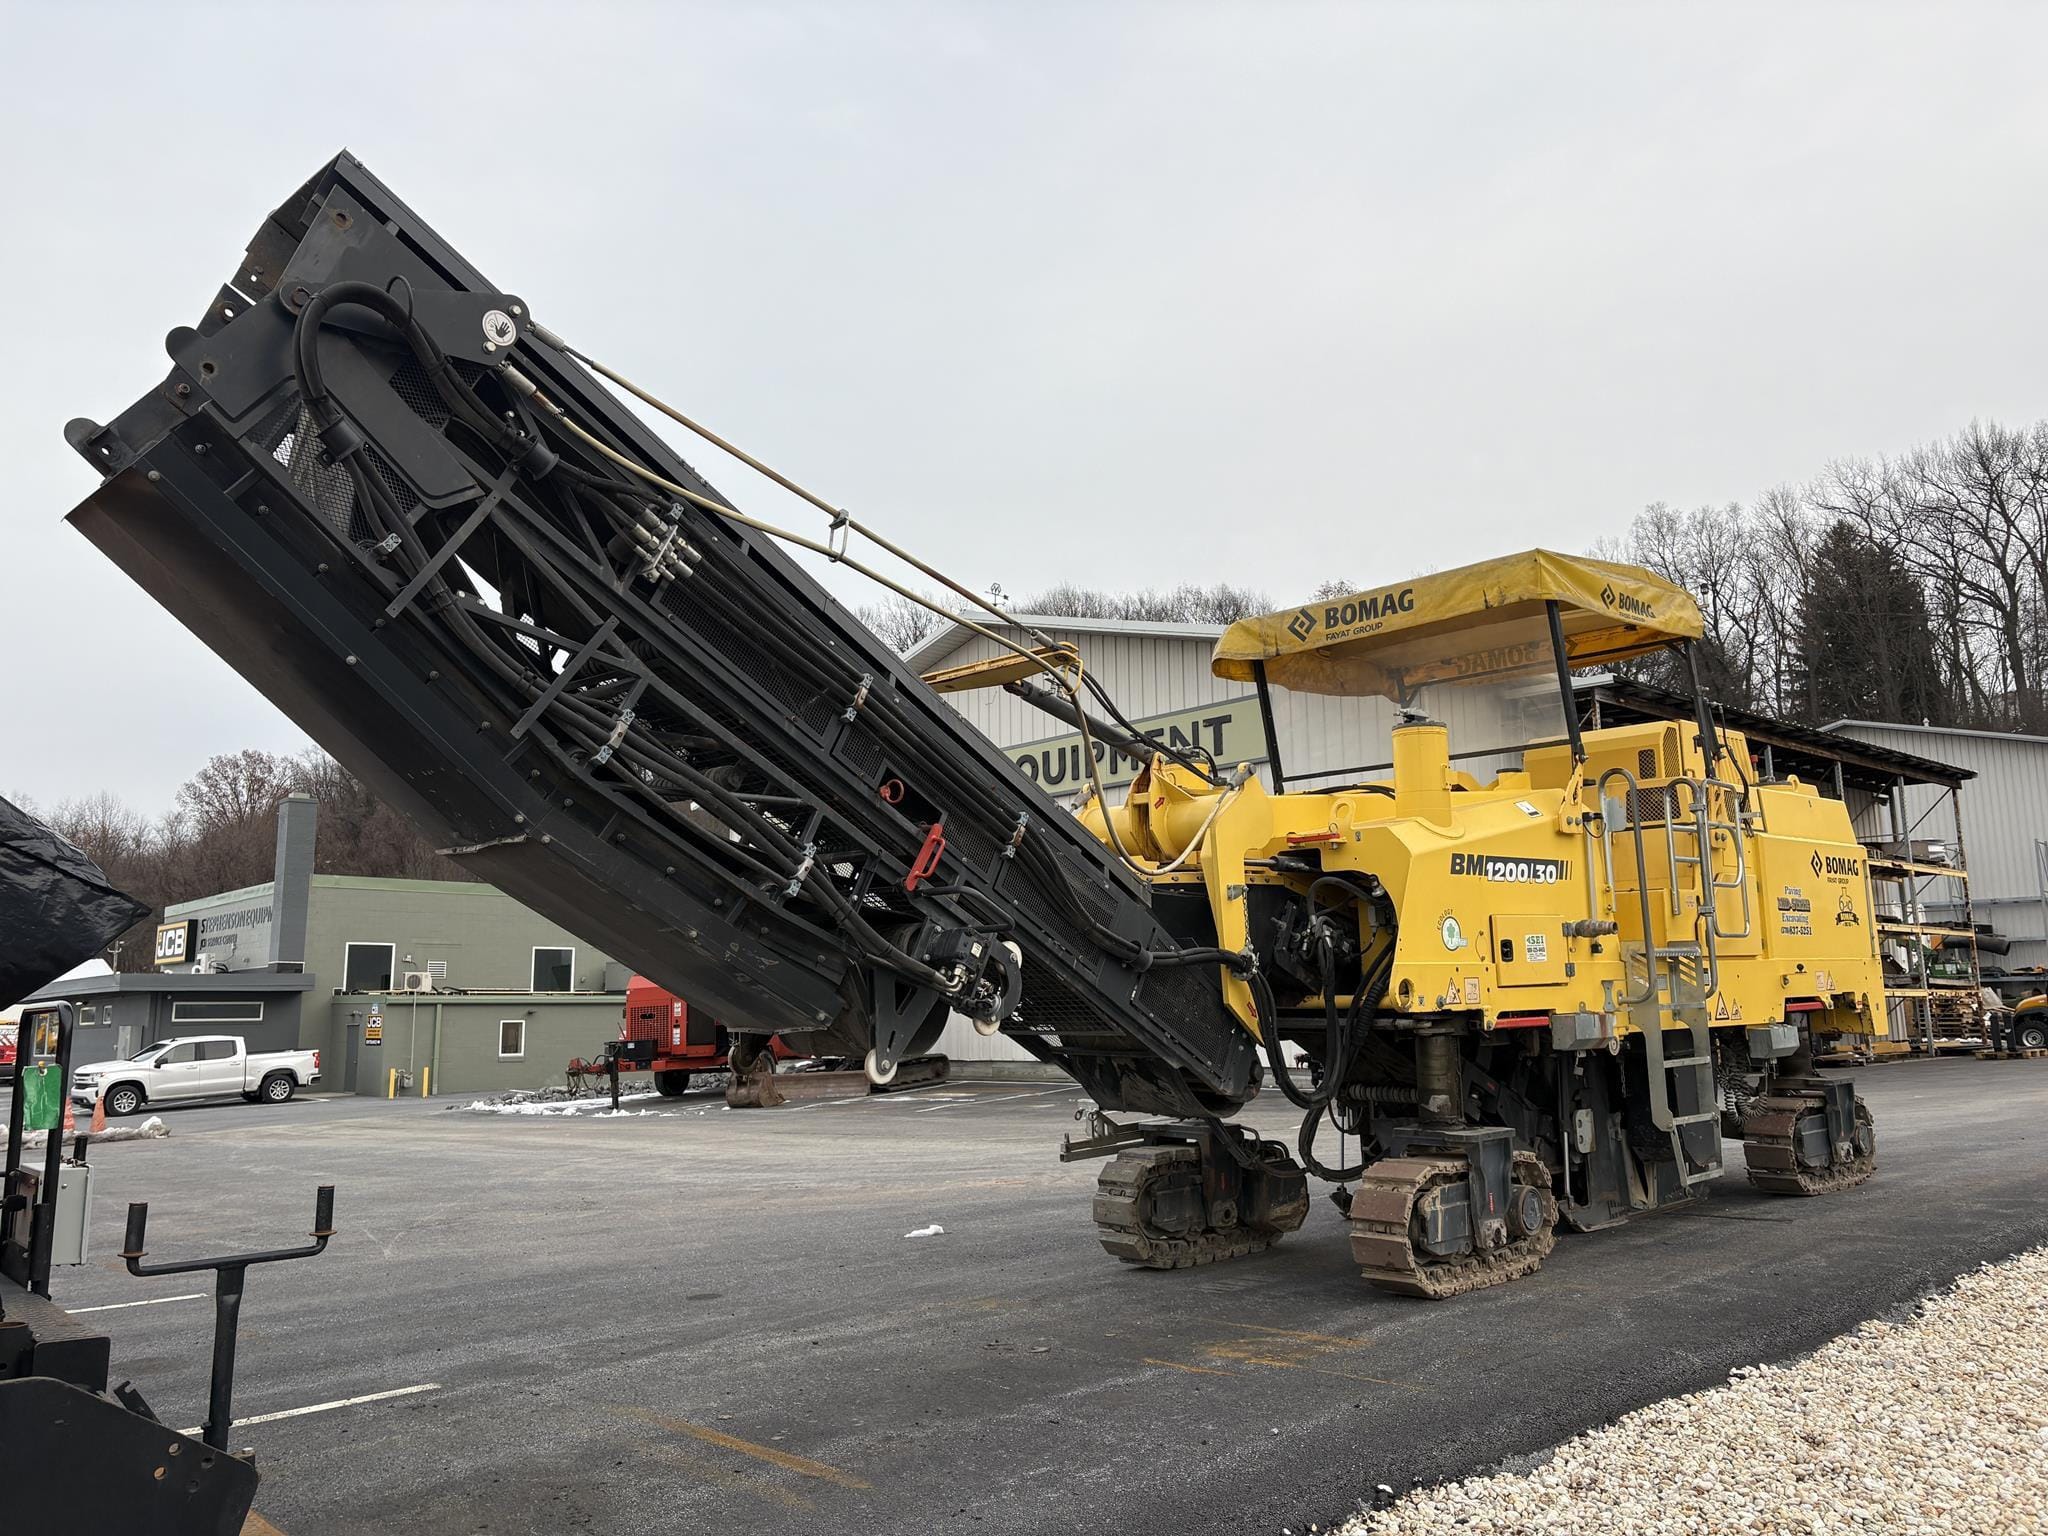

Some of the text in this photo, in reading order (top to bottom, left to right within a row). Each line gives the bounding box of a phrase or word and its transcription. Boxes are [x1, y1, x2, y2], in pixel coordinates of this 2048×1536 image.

[1325, 588, 1414, 629] BOMAG
[1618, 592, 1656, 618] BOMAG
[1325, 621, 1383, 641] FAYAT GROUP
[1825, 856, 1859, 877] BOMAG
[157, 928, 186, 957] JCB
[367, 1016, 381, 1028] JCB
